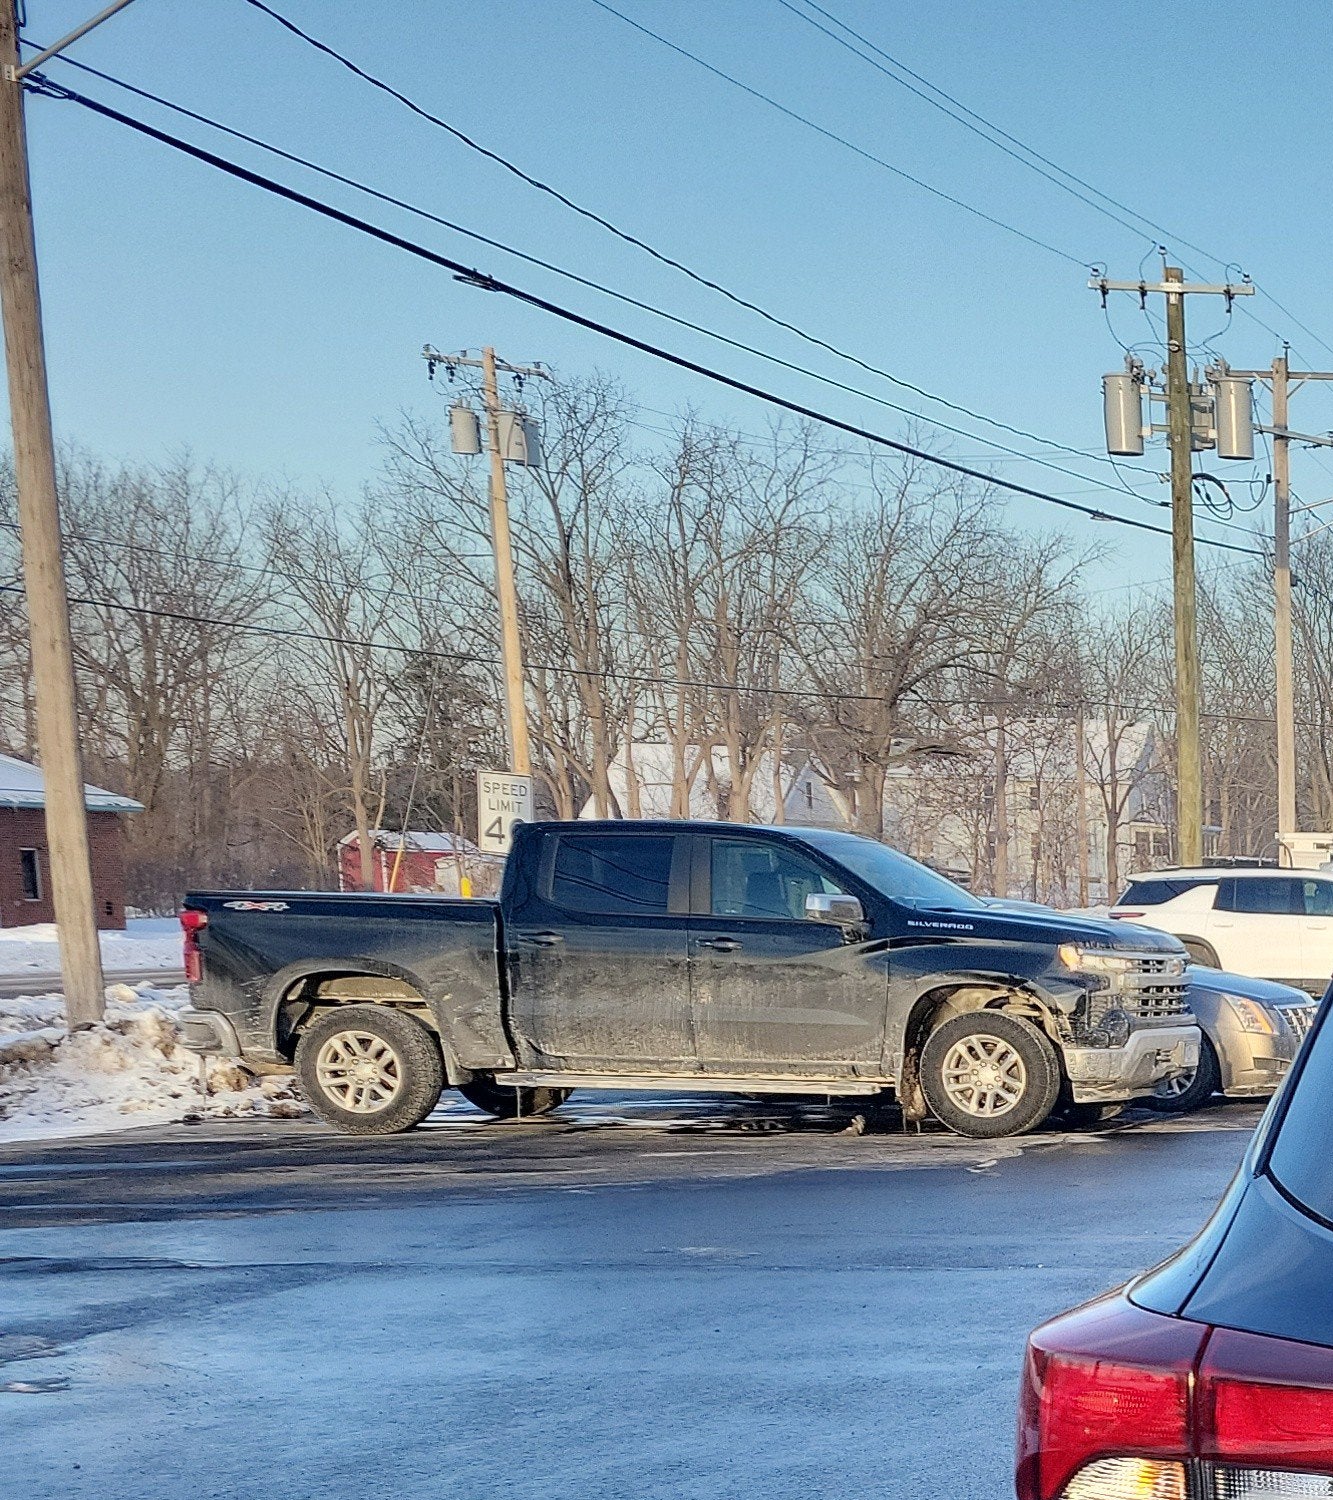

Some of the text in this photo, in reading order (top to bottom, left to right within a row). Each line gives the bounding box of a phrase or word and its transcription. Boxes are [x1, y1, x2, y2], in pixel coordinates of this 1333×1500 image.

[483, 781, 528, 797] SPEED
[488, 798, 524, 813] LIMIT
[484, 816, 525, 845] 4
[907, 920, 975, 931] SILVERADO
